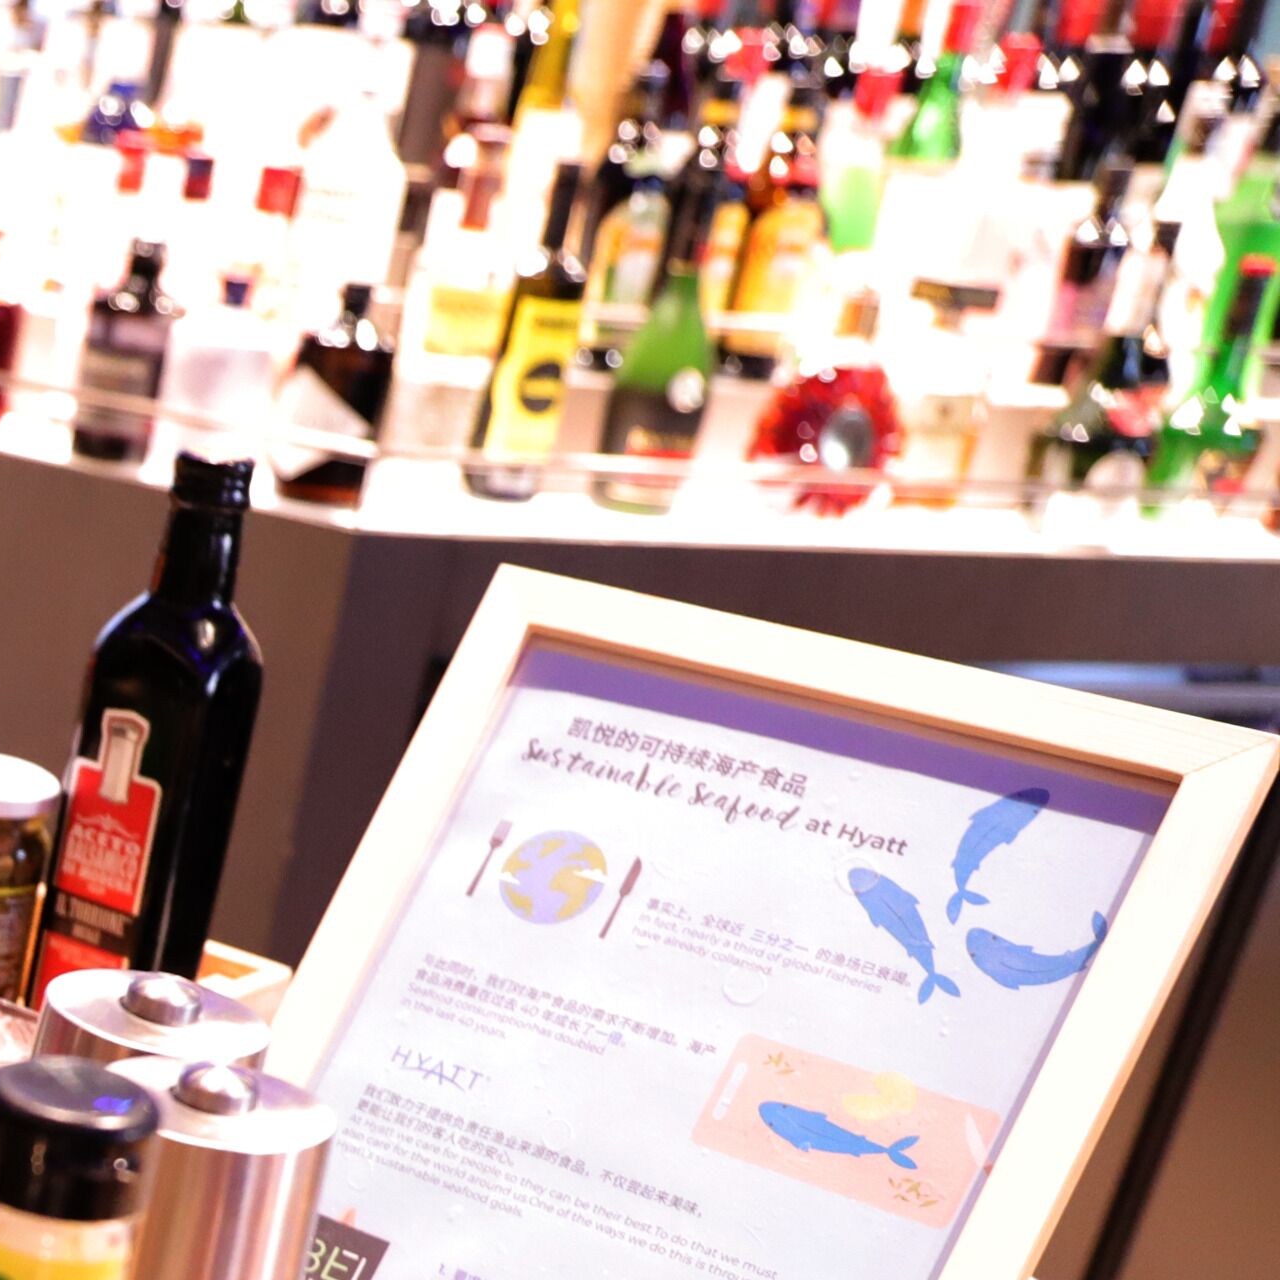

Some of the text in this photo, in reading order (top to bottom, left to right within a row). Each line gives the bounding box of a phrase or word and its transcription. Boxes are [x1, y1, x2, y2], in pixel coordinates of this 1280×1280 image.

[564, 715, 814, 799] 凯悦的可持续海产食品
[517, 734, 911, 859] Sustainable Seafood at Hyatt
[630, 925, 663, 942] have
[661, 934, 710, 958] already
[679, 924, 720, 946] nearly
[720, 938, 732, 948] a
[732, 940, 767, 958] third
[764, 949, 783, 963] of
[779, 954, 826, 977] global
[823, 967, 884, 993] fisheries
[748, 927, 812, 956] 三分之一
[406, 981, 455, 1006] Seafood
[552, 1030, 607, 1056] doubled
[411, 1000, 435, 1015] the
[433, 1007, 455, 1022] last
[455, 1015, 474, 1029] 40
[517, 1004, 540, 1018] 40
[387, 1044, 484, 1096] HYATT
[340, 1126, 366, 1142] also
[365, 1135, 392, 1152] care
[391, 1144, 408, 1158] for
[408, 1151, 432, 1167] the
[431, 1159, 467, 1180] world
[465, 1172, 512, 1197] around
[554, 1205, 571, 1219] of
[569, 1211, 594, 1228] the
[592, 1220, 627, 1242] ways
[627, 1232, 648, 1248] we
[647, 1240, 668, 1256] do
[666, 1247, 695, 1265] this
[693, 1257, 707, 1270] is
[373, 1153, 442, 1186] sustainable
[440, 1178, 490, 1204] seafood
[396, 1129, 415, 1144] we
[413, 1136, 442, 1154] care
[441, 1146, 460, 1161] for
[458, 1153, 503, 1178] people
[502, 1169, 520, 1183] so
[517, 1175, 547, 1195] they
[547, 1186, 573, 1203] can
[572, 1195, 593, 1211] be
[590, 1202, 623, 1222] their
[669, 1231, 690, 1247] do
[688, 1239, 719, 1258] that
[717, 1250, 742, 1267] we
[739, 1258, 779, 1280] must
